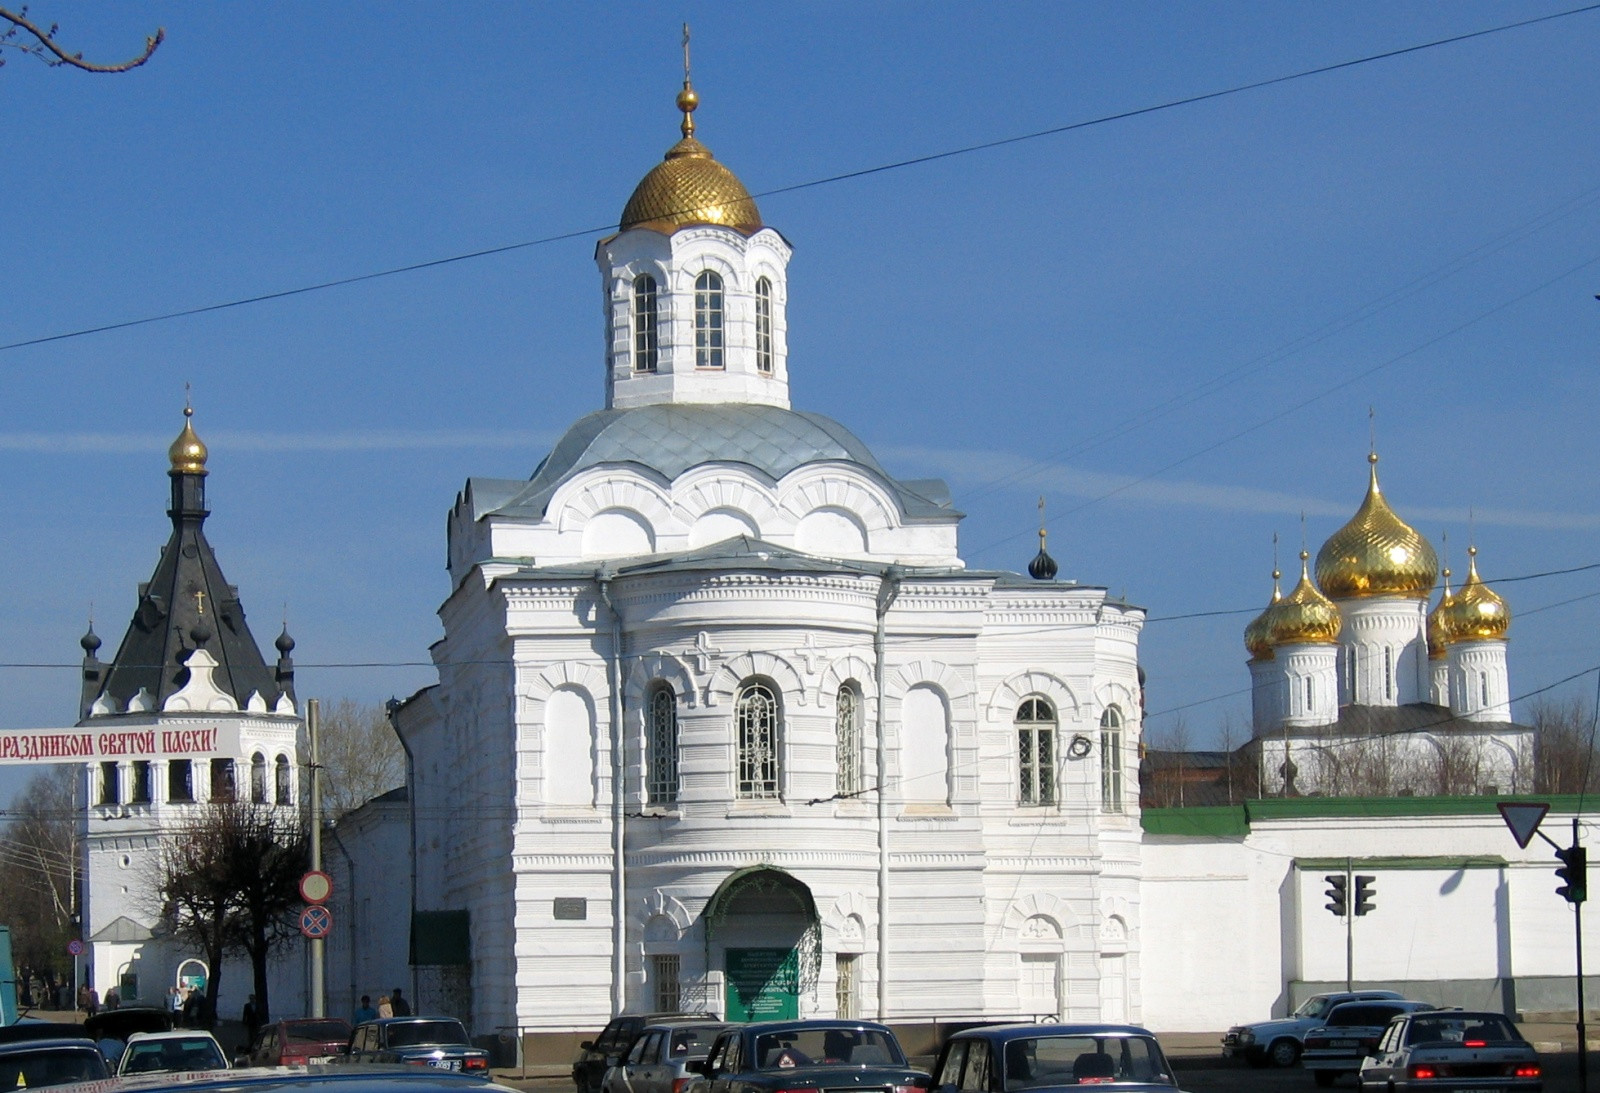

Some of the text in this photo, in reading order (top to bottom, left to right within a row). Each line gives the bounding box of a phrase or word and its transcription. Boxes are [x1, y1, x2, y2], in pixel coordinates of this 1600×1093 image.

[0, 727, 218, 760] РАЗДНИКОМ СВЯТОЙ ПАСХИ!
